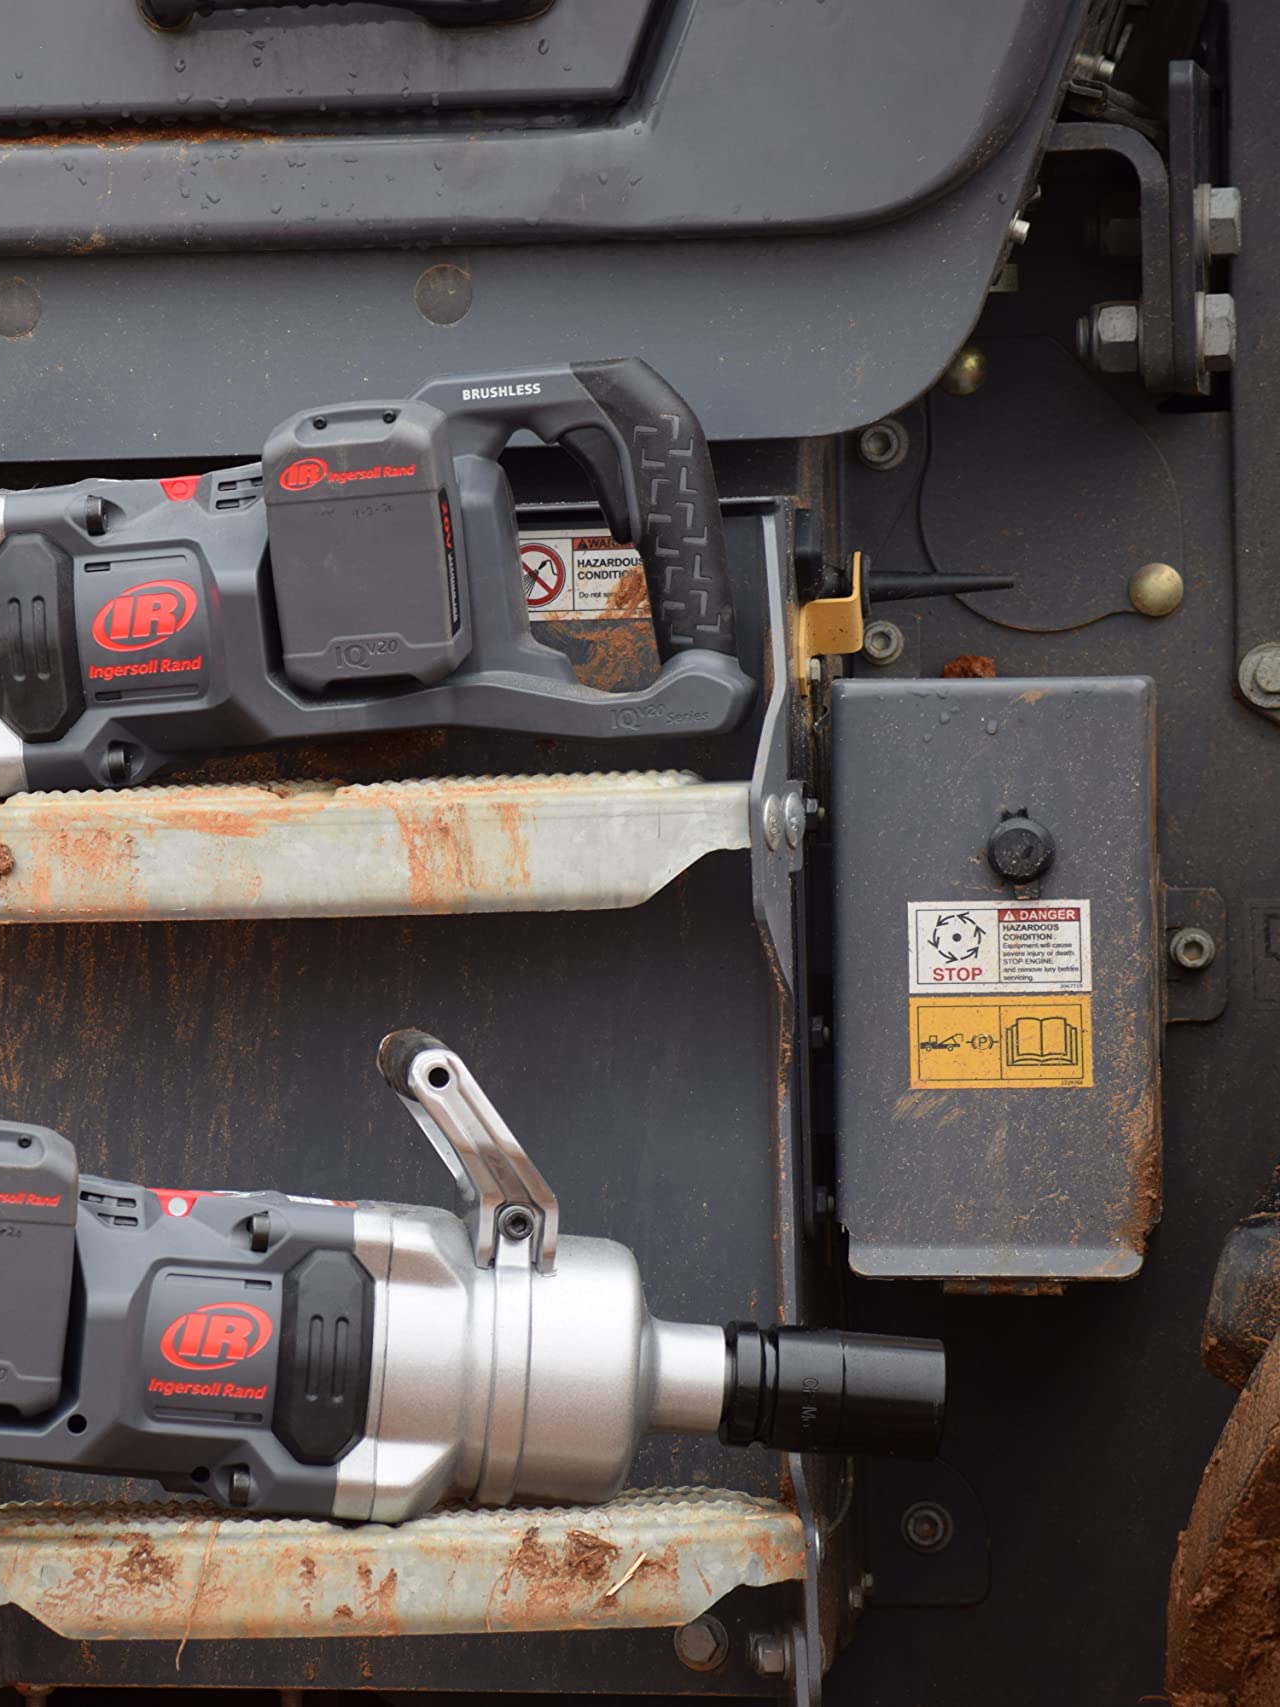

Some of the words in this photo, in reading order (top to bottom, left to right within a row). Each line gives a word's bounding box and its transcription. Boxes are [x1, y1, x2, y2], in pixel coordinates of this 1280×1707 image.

[462, 383, 541, 401] BRUSHLESS
[327, 465, 382, 484] Ingersoll
[383, 463, 416, 478] Rand
[88, 659, 158, 681] Ingersoll
[160, 655, 202, 673] Rand
[665, 709, 710, 725] Series
[1020, 909, 1076, 920] DANGER
[1002, 923, 1060, 931] HAZARDOUS
[1002, 933, 1053, 941] CONDITION
[1002, 942, 1039, 950] Equipment
[933, 967, 983, 982] STOP
[26, 1192, 62, 1208] Rand
[148, 1377, 222, 1397] Ingersoll
[222, 1383, 268, 1400] Rand
